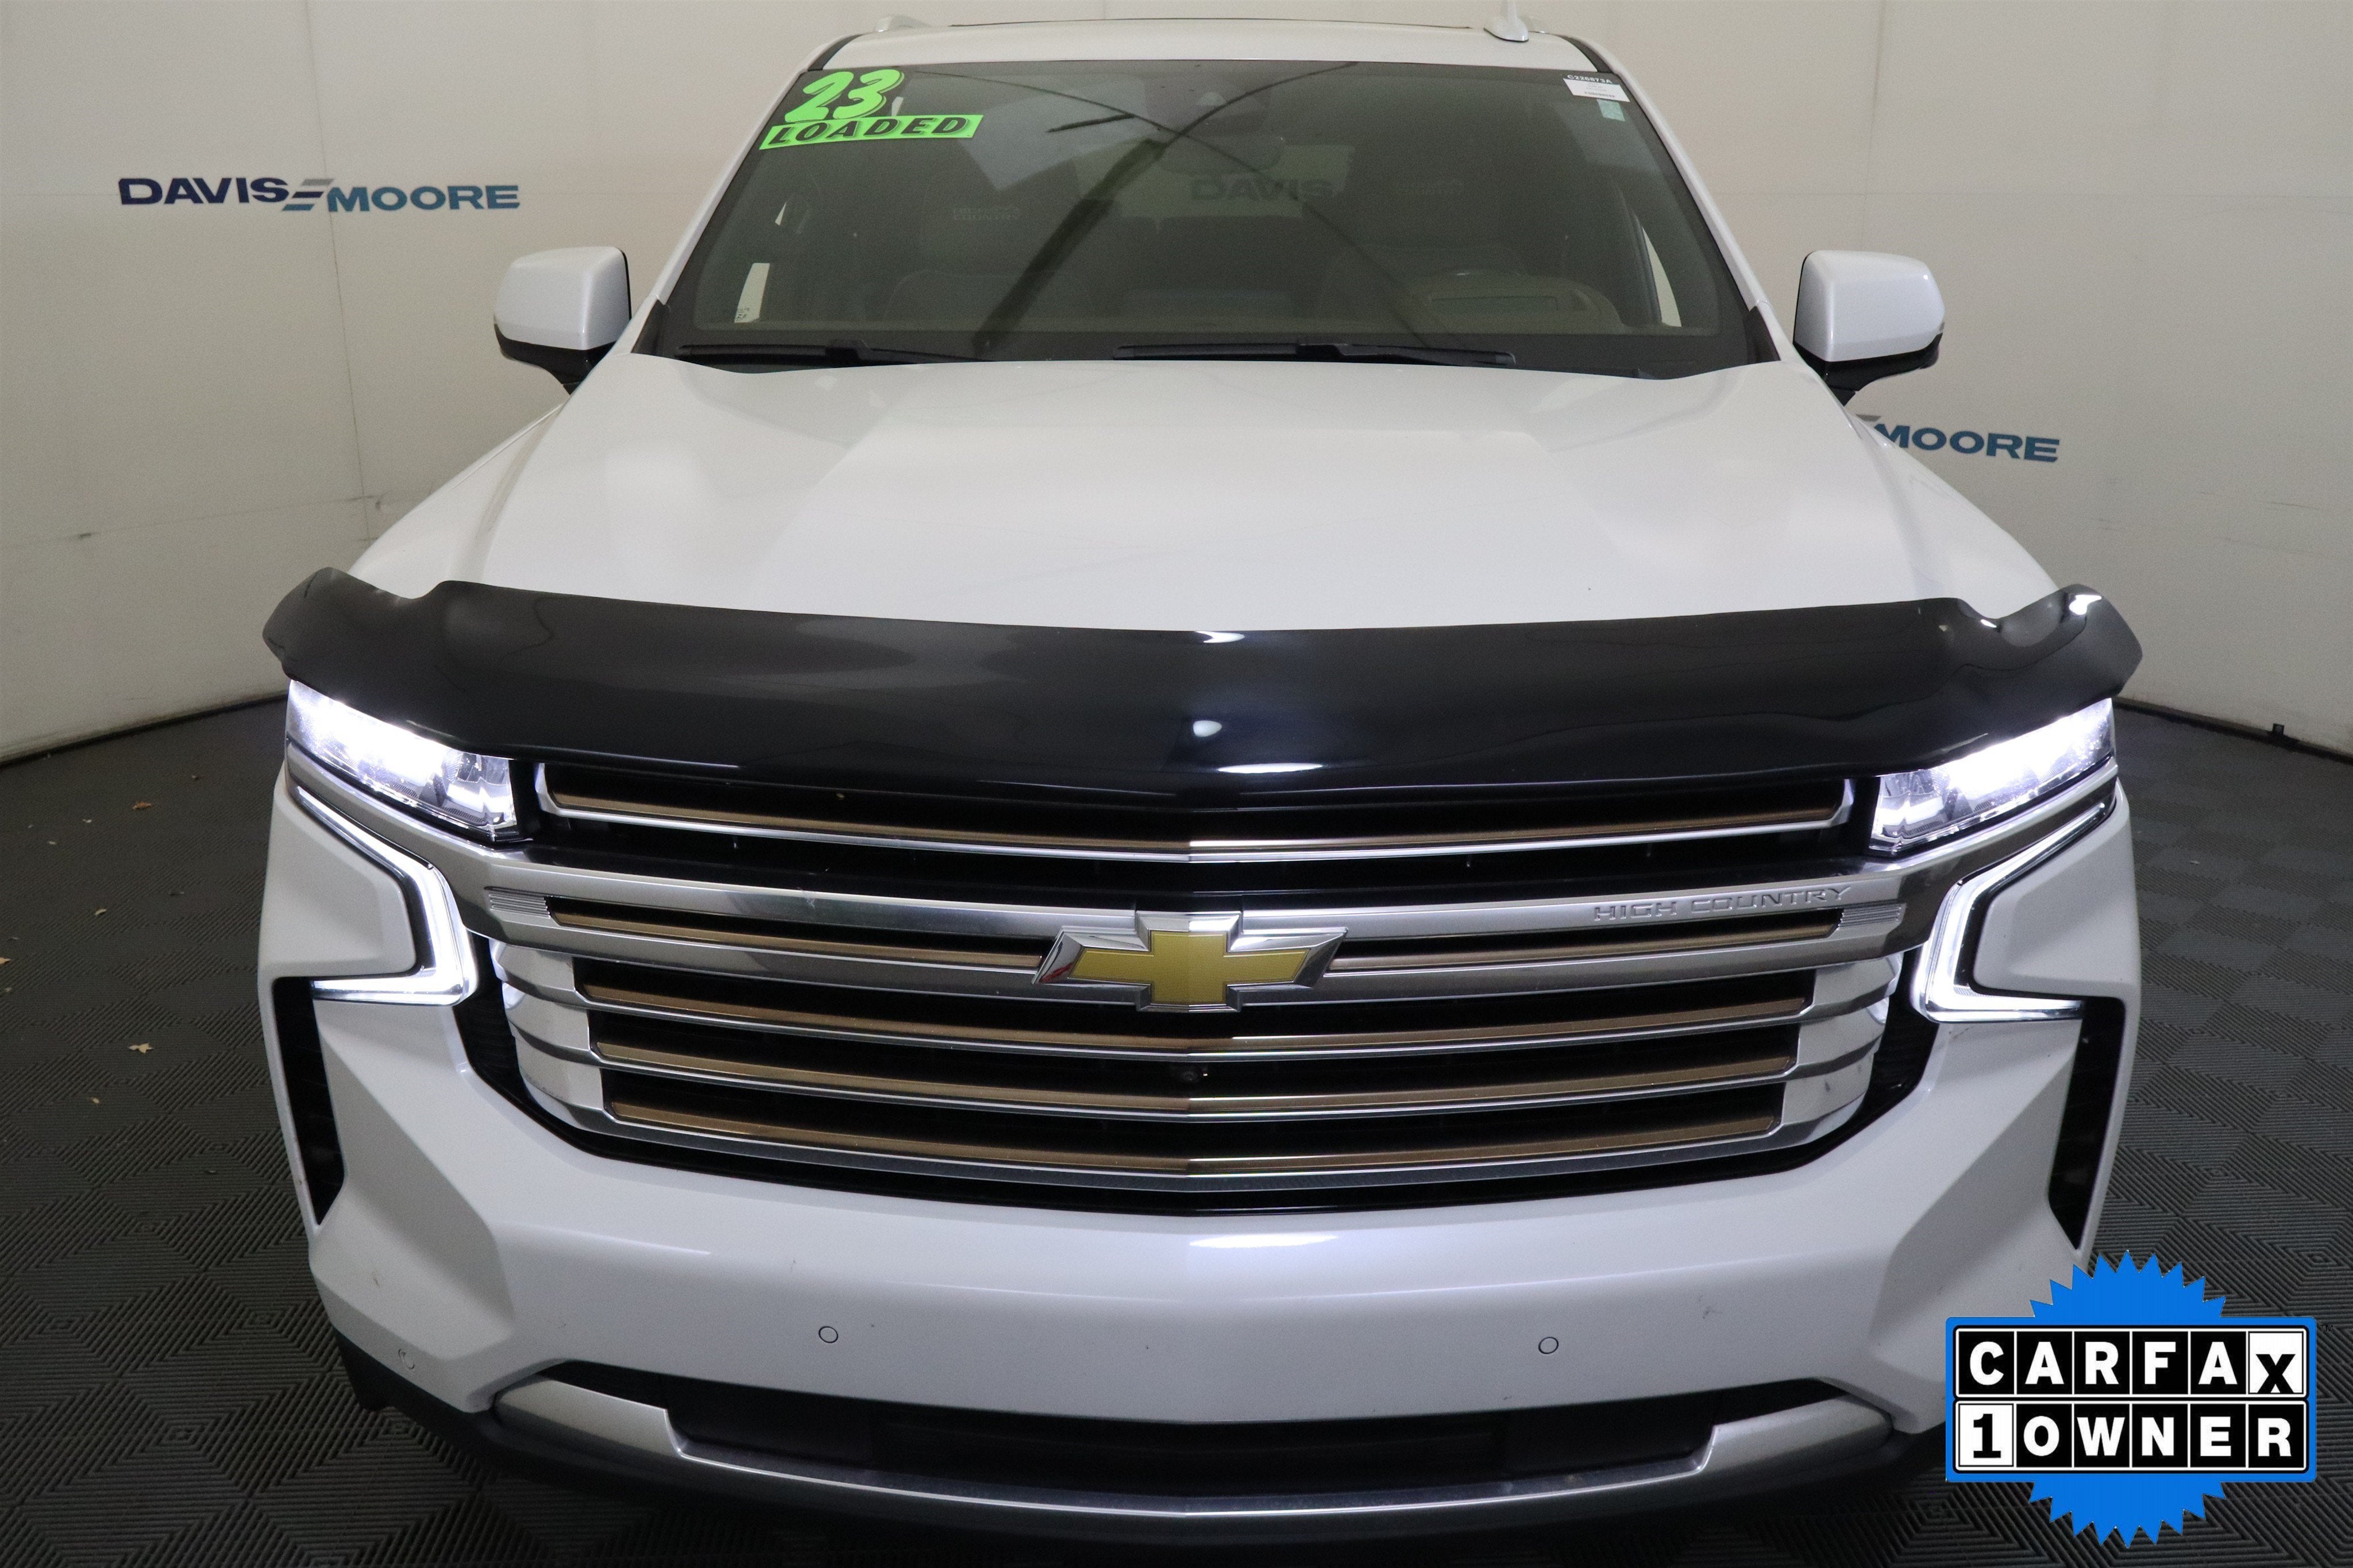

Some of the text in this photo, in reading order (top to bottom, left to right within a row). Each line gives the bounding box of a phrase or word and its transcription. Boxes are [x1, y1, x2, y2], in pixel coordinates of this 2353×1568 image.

[785, 69, 904, 123] 23
[768, 117, 969, 146] LOADED
[118, 177, 520, 212] DAVIS MOORE
[1874, 423, 2060, 463] MOORE
[1594, 886, 1851, 921] HIGH COUNTRY
